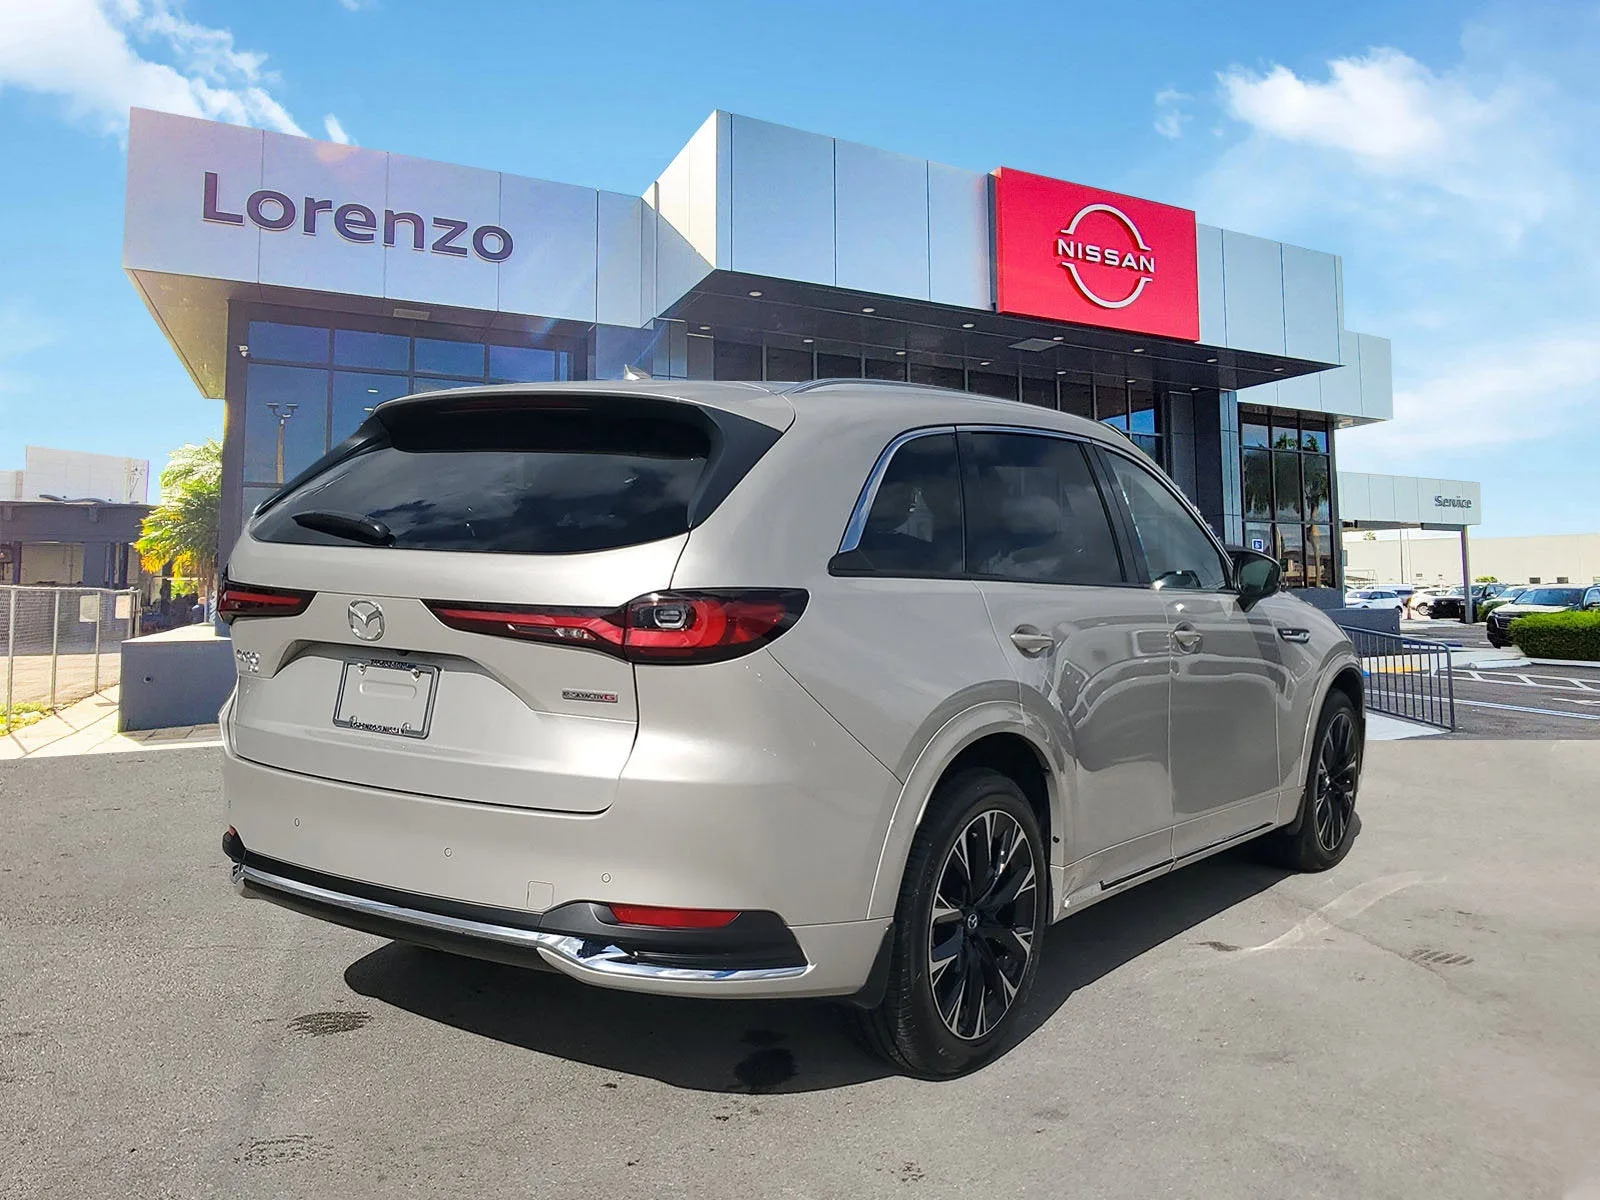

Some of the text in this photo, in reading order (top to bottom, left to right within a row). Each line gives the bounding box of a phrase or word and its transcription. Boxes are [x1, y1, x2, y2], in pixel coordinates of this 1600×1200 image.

[203, 171, 514, 262] Lorenzo
[1057, 238, 1155, 273] NISSAN
[1434, 495, 1472, 508] Service
